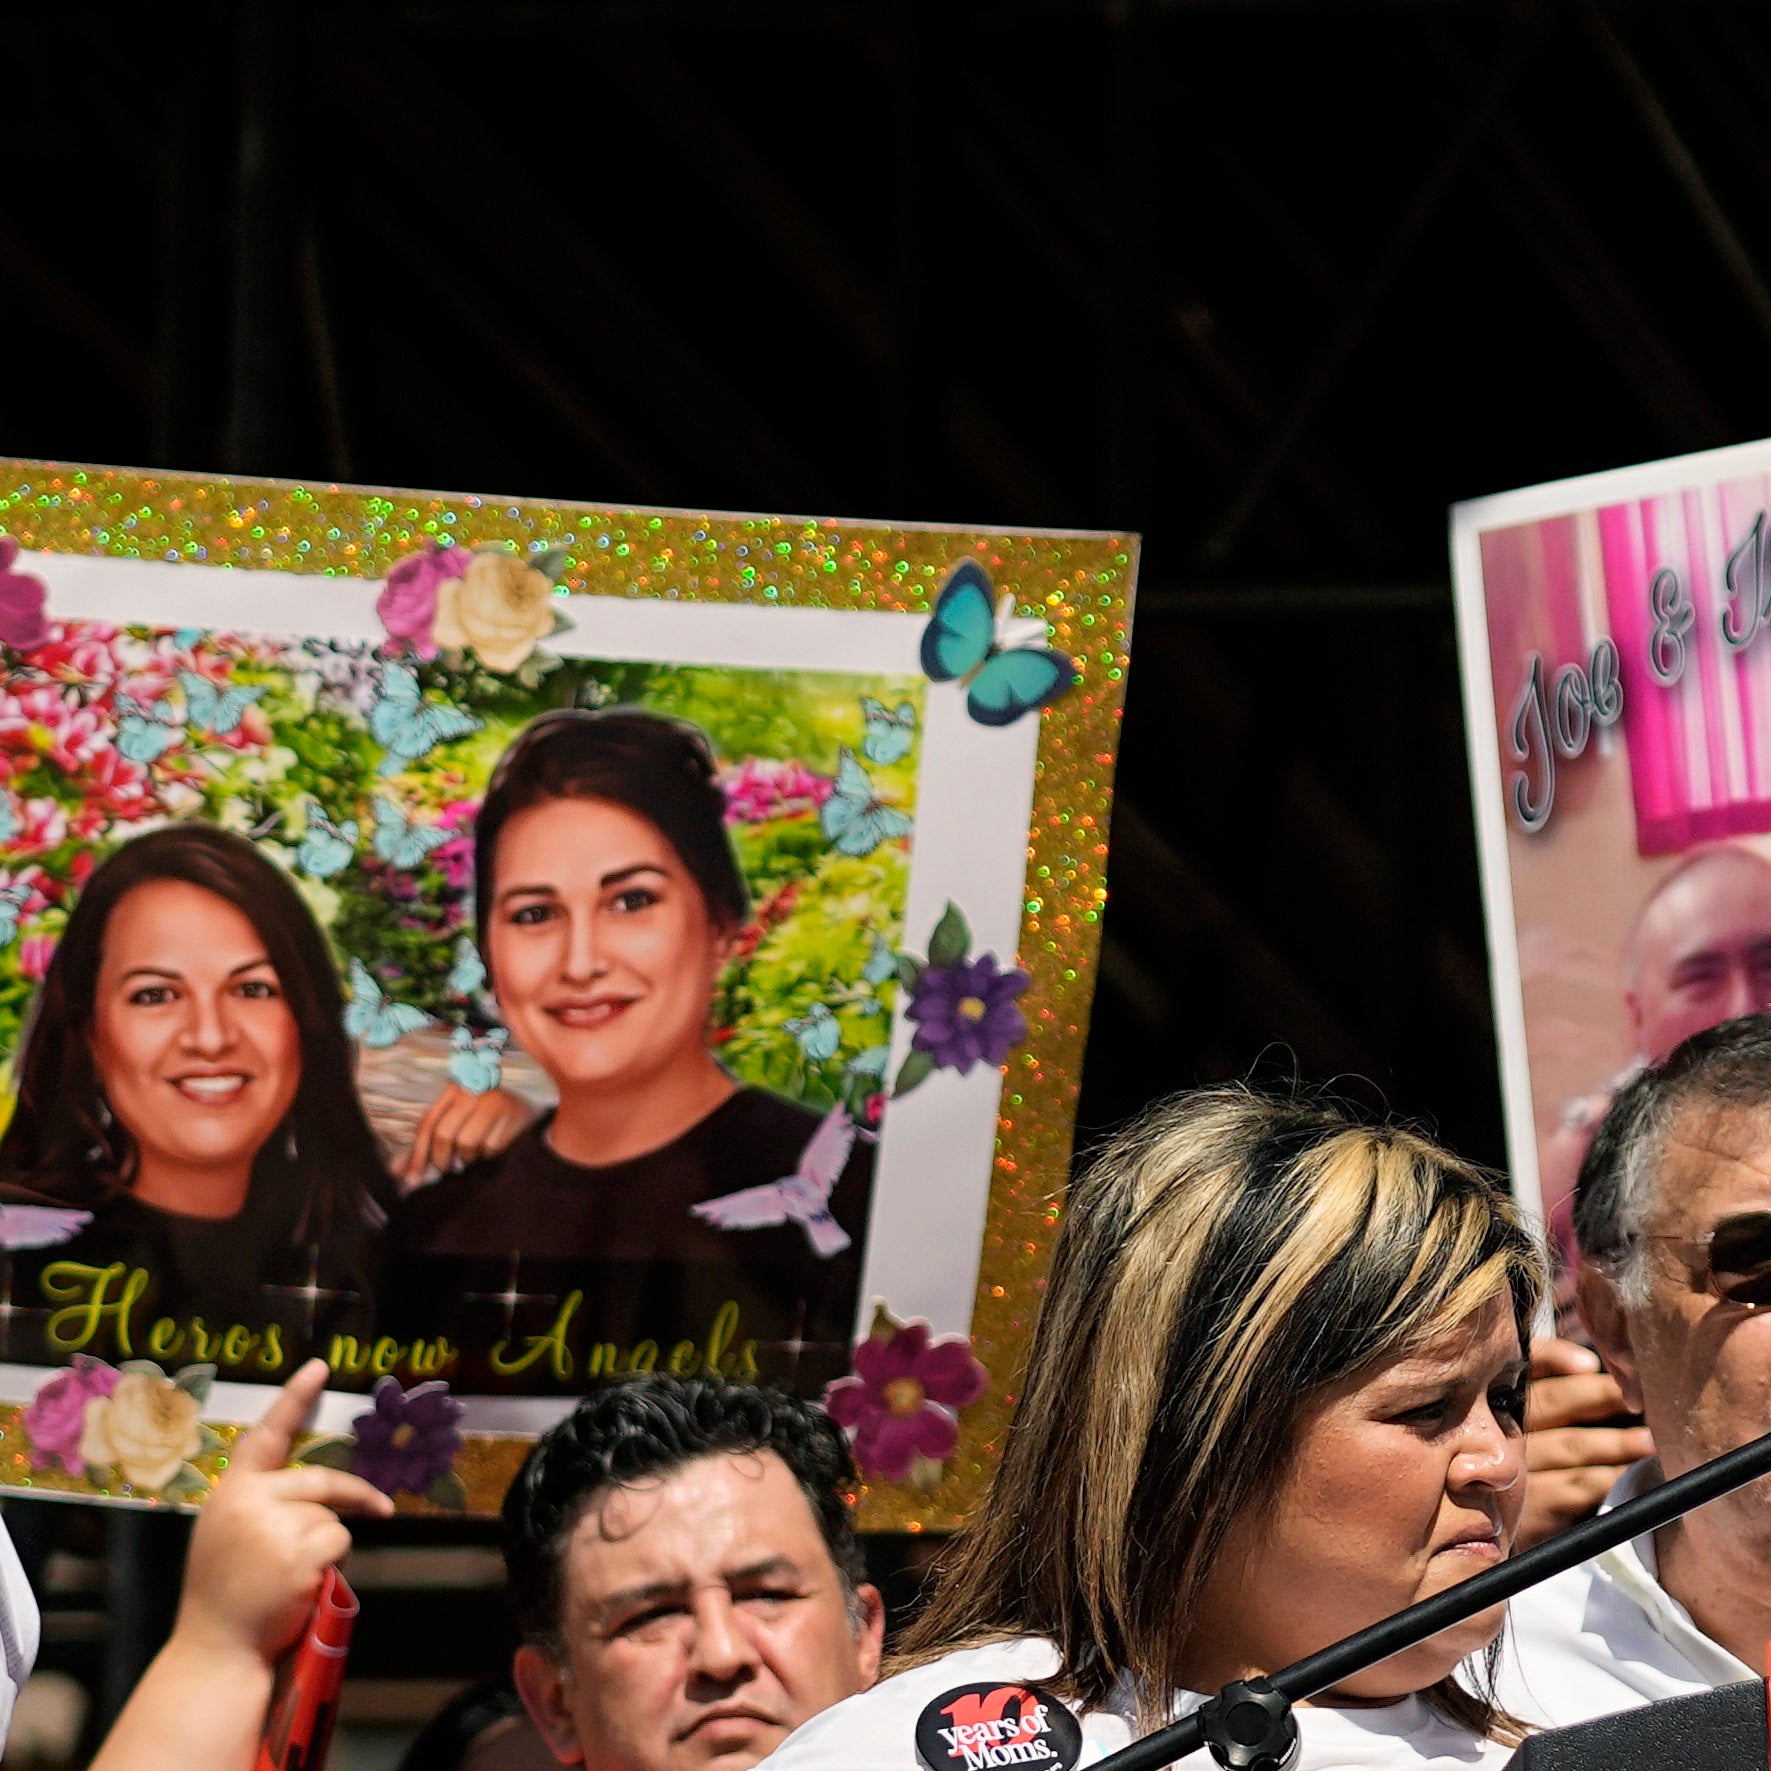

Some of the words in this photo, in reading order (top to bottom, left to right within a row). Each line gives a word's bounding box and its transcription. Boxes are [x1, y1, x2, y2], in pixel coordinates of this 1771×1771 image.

[1511, 634, 1622, 833] Joe
[1649, 565, 1694, 686] &
[41, 1260, 283, 1373] Heros
[329, 1332, 457, 1377] now
[937, 1716, 1020, 1755] years
[1021, 1704, 1052, 1734] of
[960, 1738, 1058, 1771] Moms.
